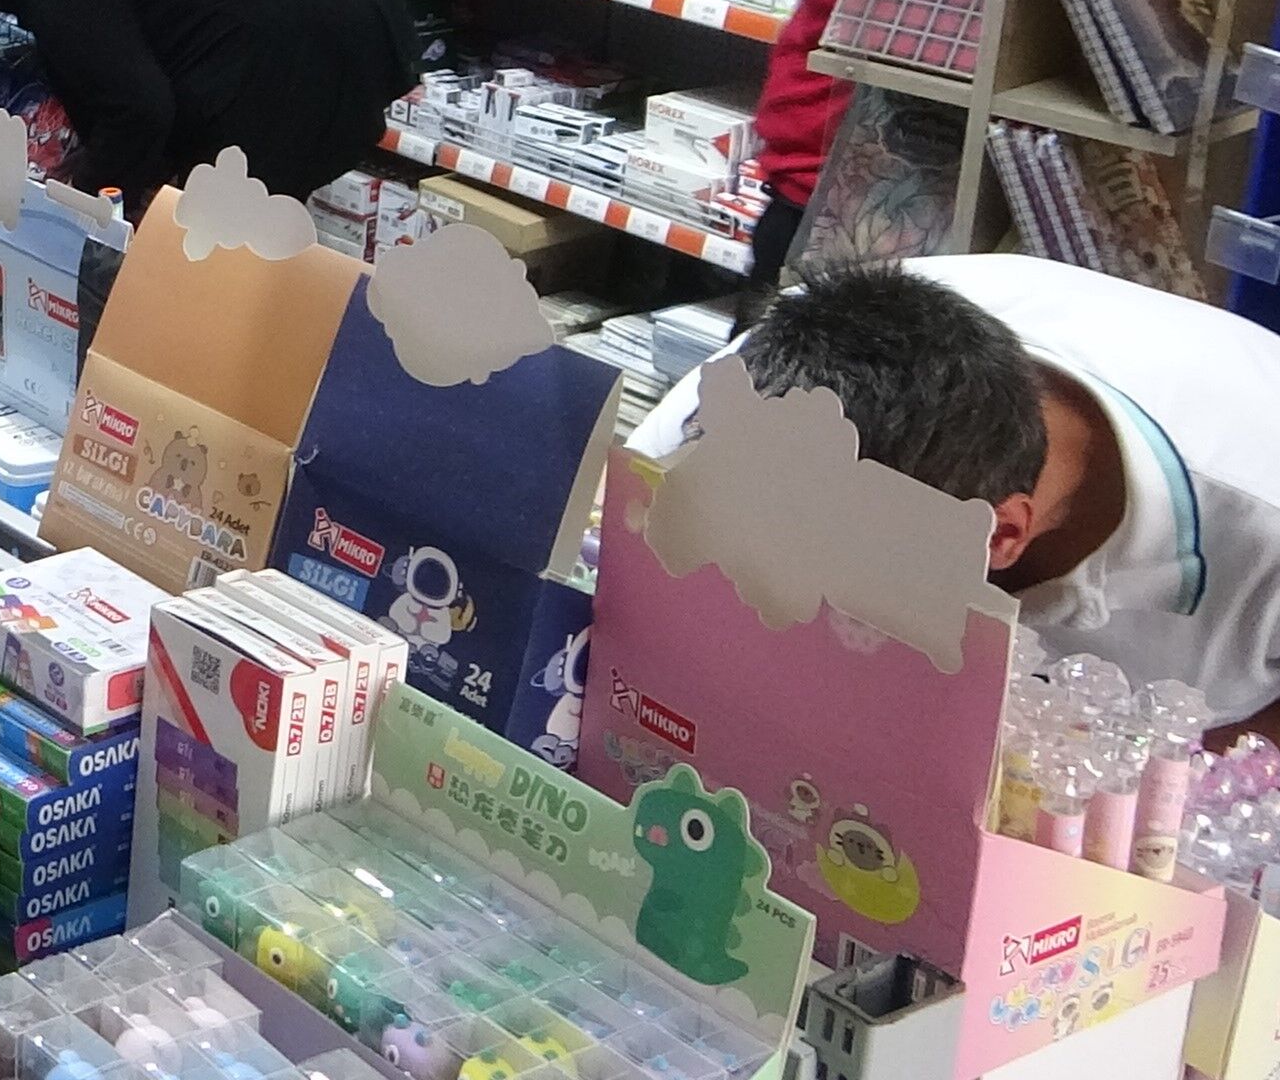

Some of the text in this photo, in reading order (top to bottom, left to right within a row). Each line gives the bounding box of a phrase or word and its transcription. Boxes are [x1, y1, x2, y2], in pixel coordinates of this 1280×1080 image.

[136, 486, 249, 563] CAPYBARA
[209, 506, 224, 522] 24
[458, 686, 489, 708] Adet
[463, 662, 493, 693] 24
[38, 786, 101, 826] OSAKA
[508, 766, 590, 835] DINO
[30, 816, 96, 853] OSAKA
[33, 847, 94, 887] OSAKA
[27, 879, 90, 919] OSAKA
[755, 898, 797, 930] 24 PCS
[27, 914, 91, 953] OSAKA
